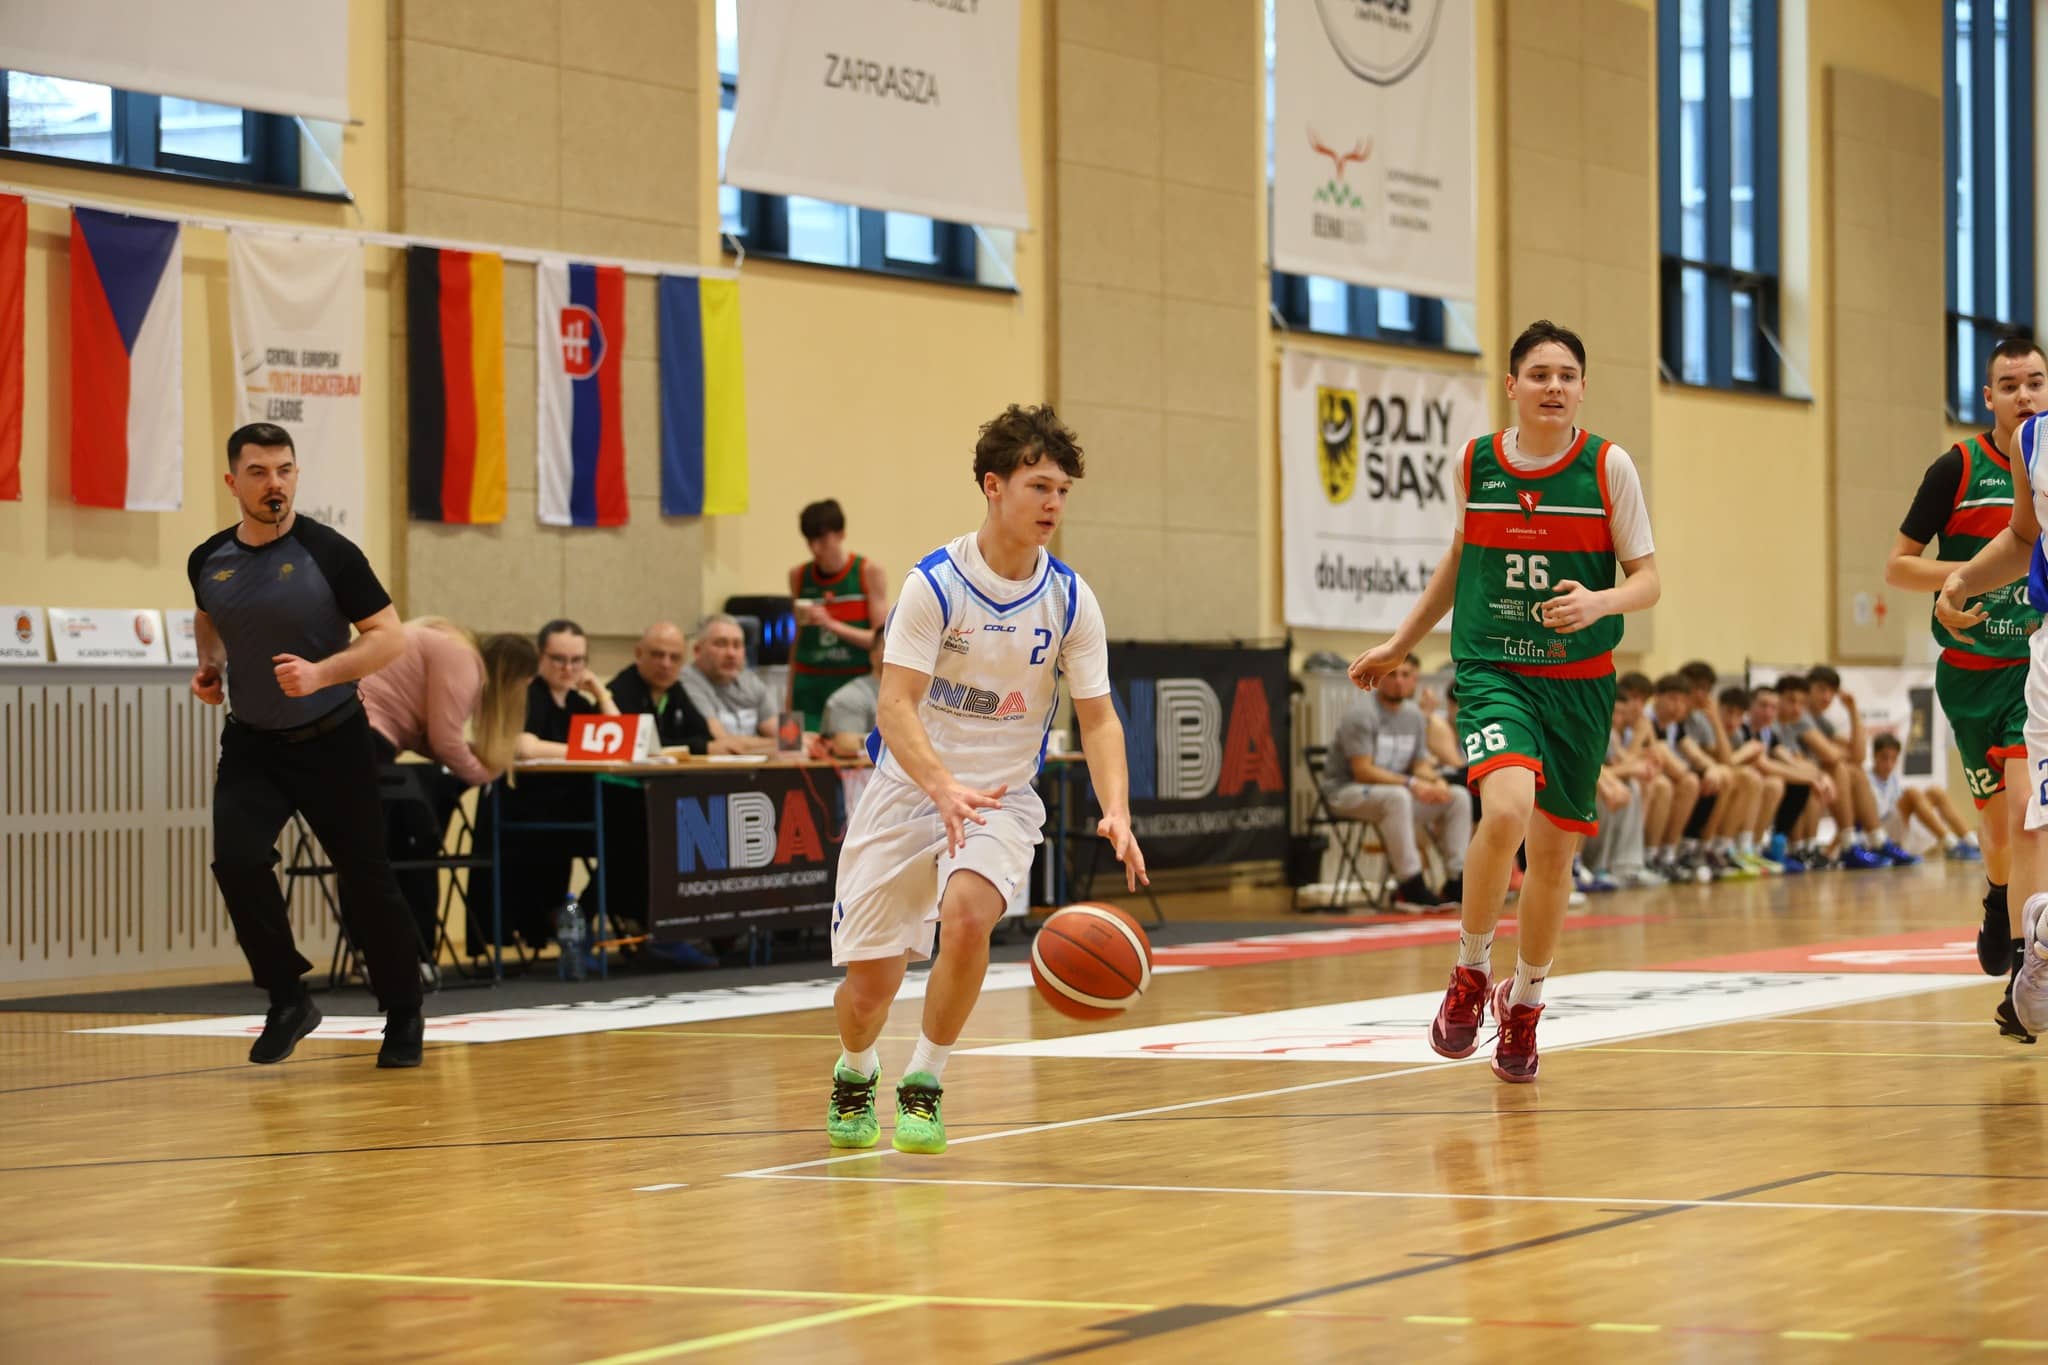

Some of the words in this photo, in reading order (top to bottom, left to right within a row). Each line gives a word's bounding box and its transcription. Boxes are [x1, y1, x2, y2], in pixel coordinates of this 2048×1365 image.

[824, 53, 939, 106] ZAPRASZA
[267, 399, 303, 422] LEAGUE
[1505, 553, 1550, 590] 26
[983, 625, 1016, 633] COLO
[1029, 628, 1052, 665] 2
[930, 676, 1027, 717] NBA
[581, 722, 624, 755] 5
[1465, 723, 1507, 762] 26
[1965, 768, 1998, 795] 32
[676, 789, 825, 874] NBA
